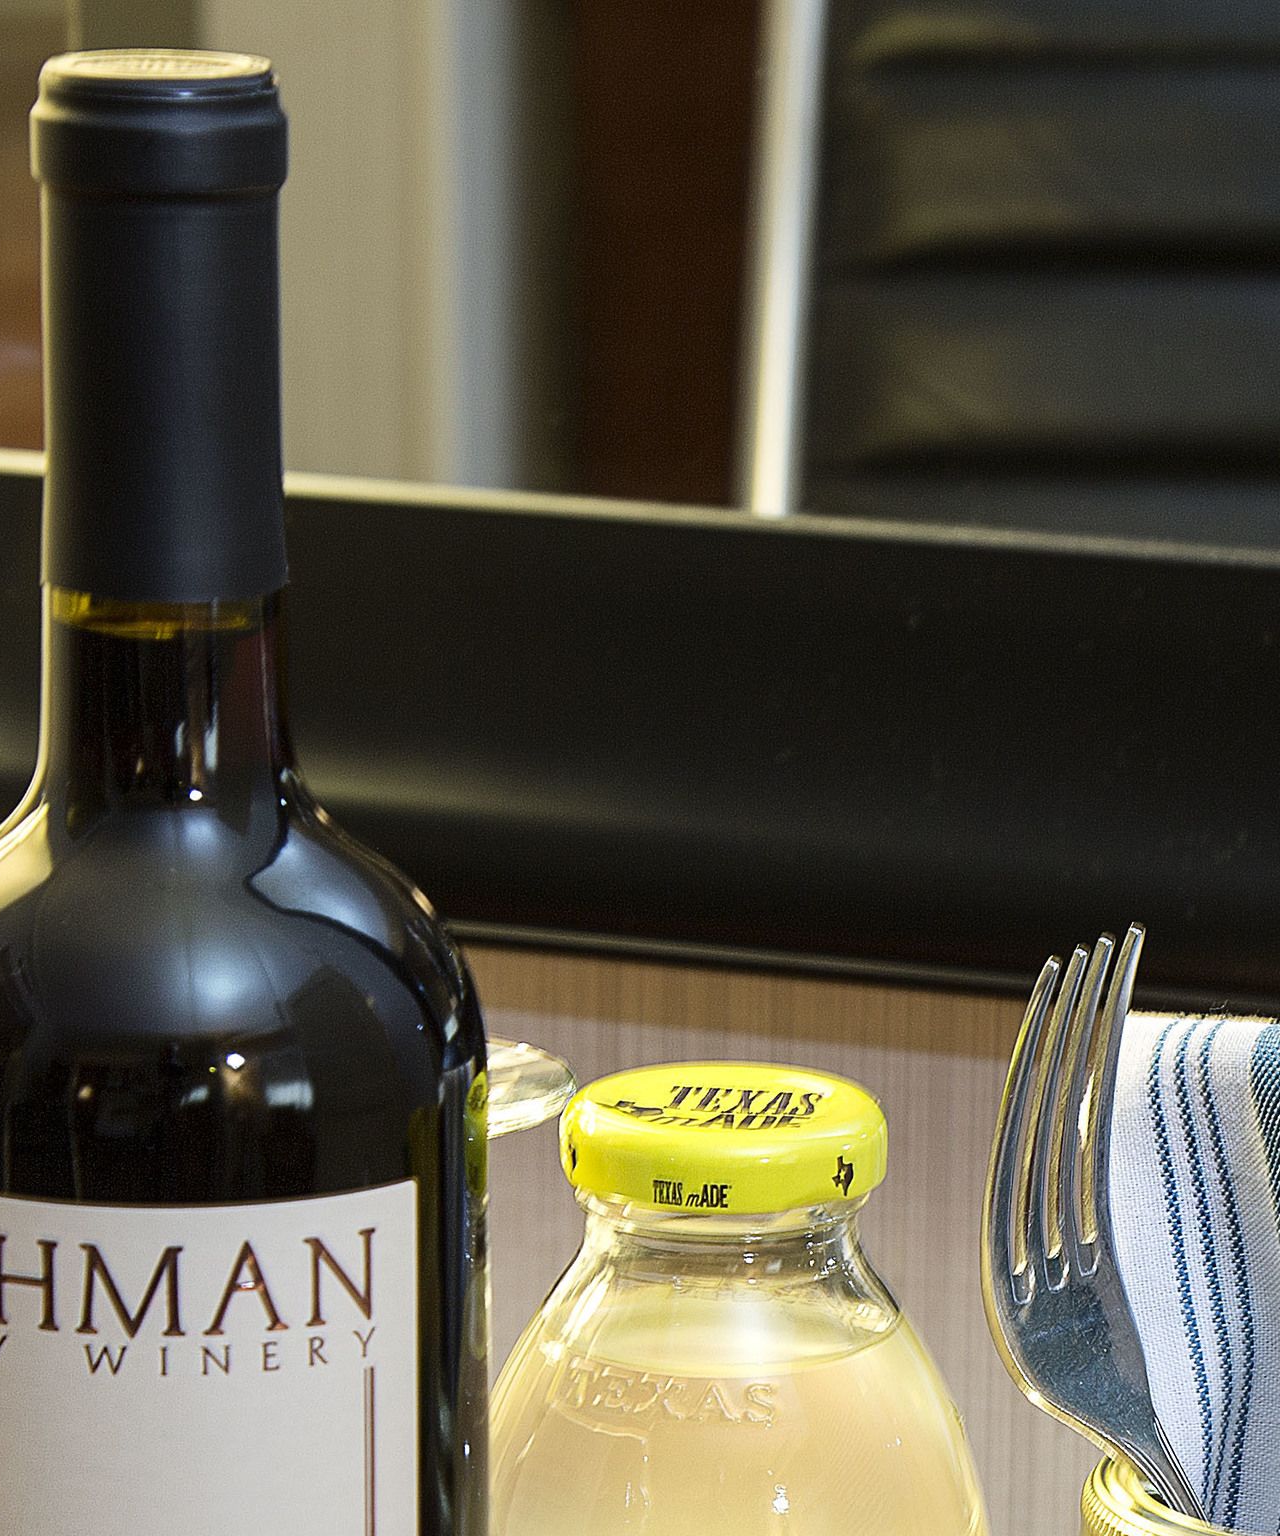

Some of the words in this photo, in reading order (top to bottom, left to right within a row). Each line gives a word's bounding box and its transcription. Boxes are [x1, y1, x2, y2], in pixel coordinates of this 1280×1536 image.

[664, 1085, 825, 1117] TEXAS
[652, 1179, 684, 1207] TEXAS
[84, 1327, 378, 1377] WINERY
